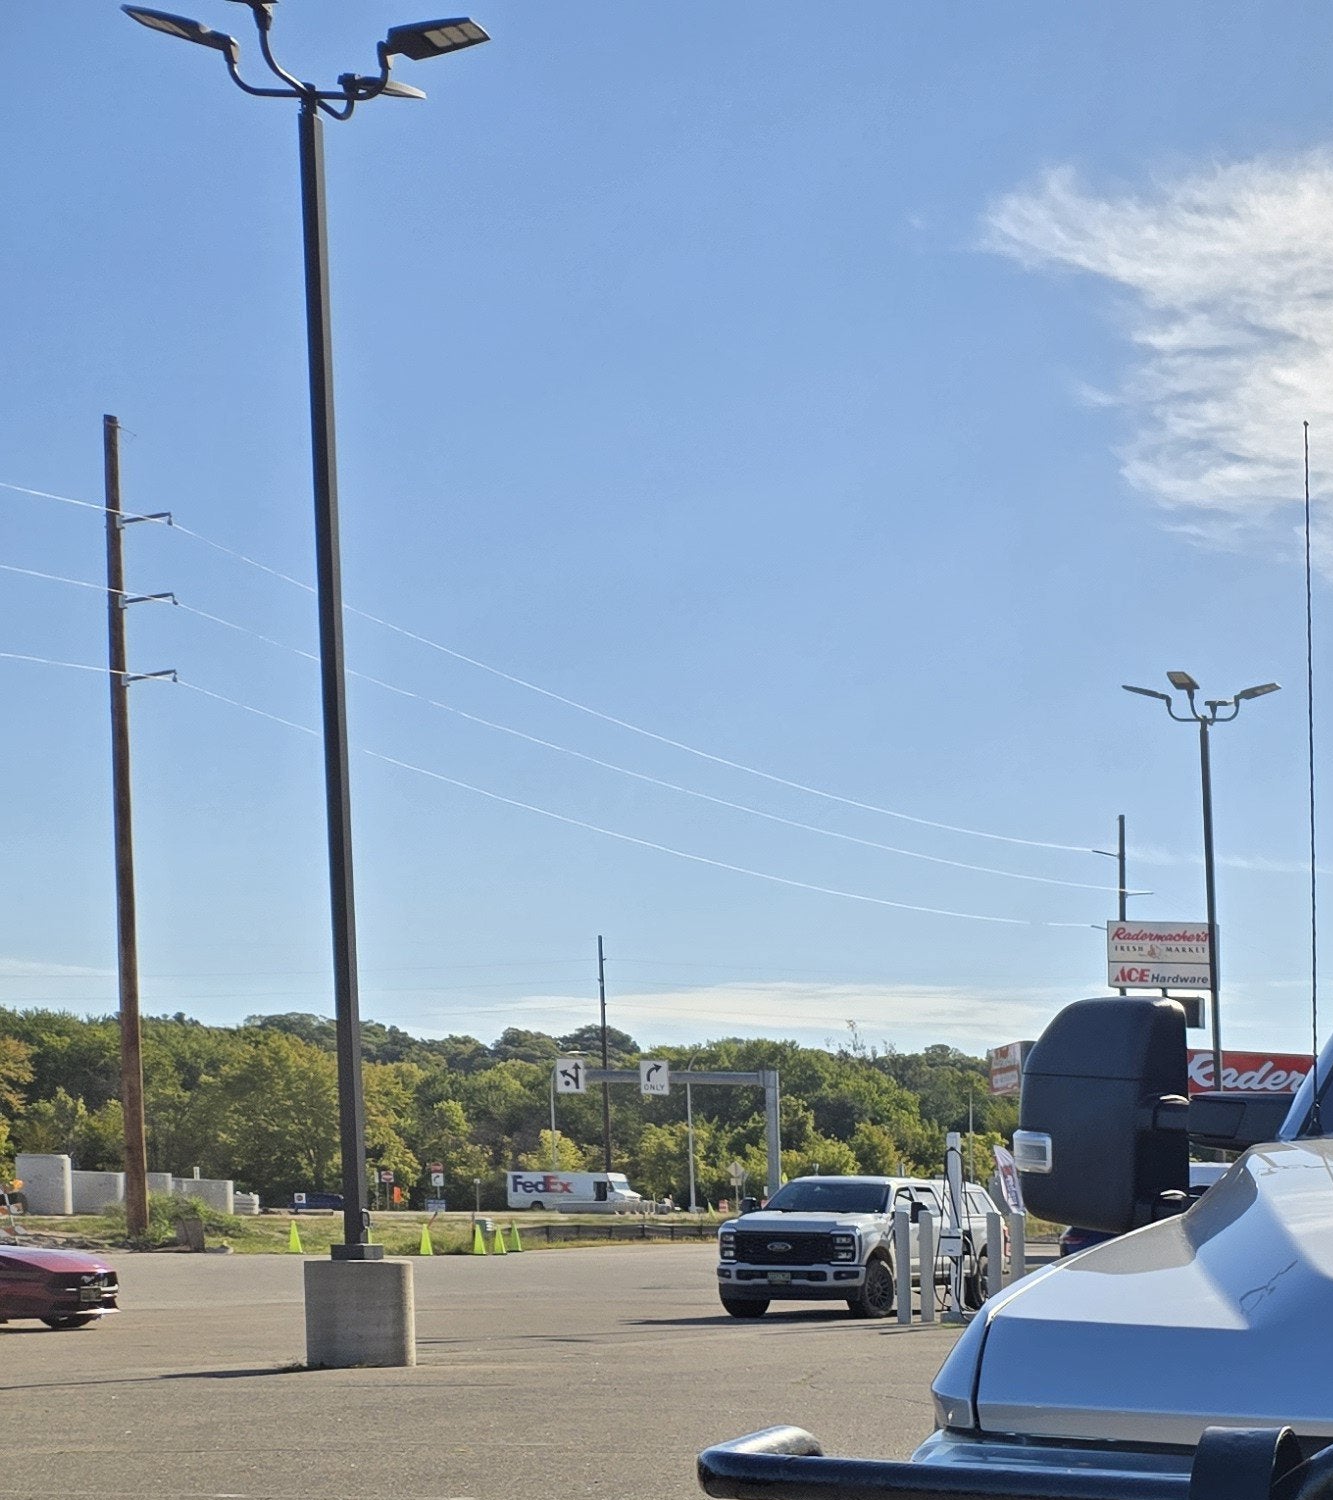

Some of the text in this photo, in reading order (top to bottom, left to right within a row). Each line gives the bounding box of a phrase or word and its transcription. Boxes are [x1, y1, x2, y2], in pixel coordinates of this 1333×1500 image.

[1112, 927, 1209, 943] Radermacher's
[1165, 946, 1206, 954] MARKET
[1114, 966, 1209, 984] ACE Hardware
[643, 1083, 665, 1091] ONLY
[511, 1174, 573, 1194] FedEx
